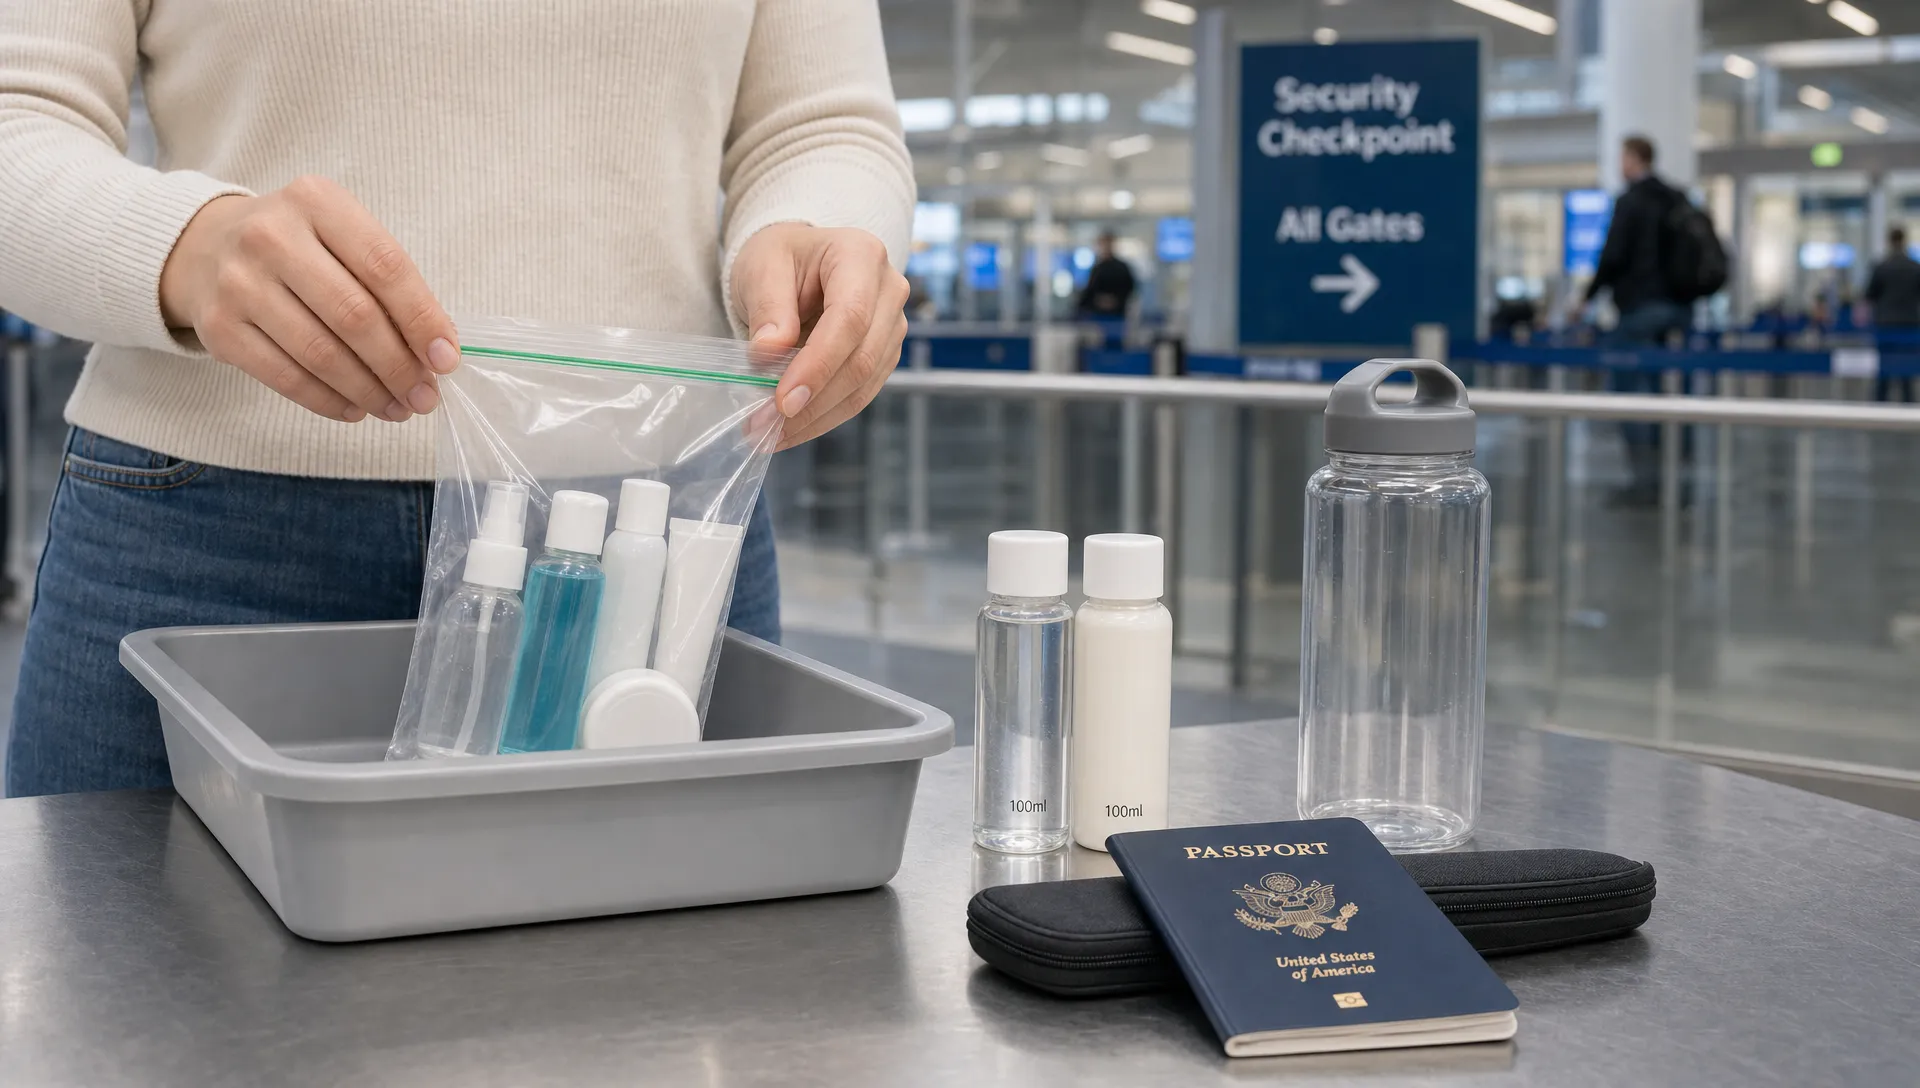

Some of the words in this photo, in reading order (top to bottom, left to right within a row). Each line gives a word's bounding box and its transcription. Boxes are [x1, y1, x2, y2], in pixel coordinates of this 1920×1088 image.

[1274, 74, 1420, 118] Security
[1258, 118, 1456, 162] Checkpoint
[1276, 207, 1321, 243] All
[1326, 206, 1425, 242] Gates
[1010, 799, 1047, 813] 100ml
[1105, 804, 1143, 818] 100ml
[1183, 842, 1329, 859] PASSPORT
[1276, 954, 1327, 968] United
[1330, 951, 1376, 965] States
[1291, 968, 1307, 982] of
[1312, 964, 1376, 979] America
